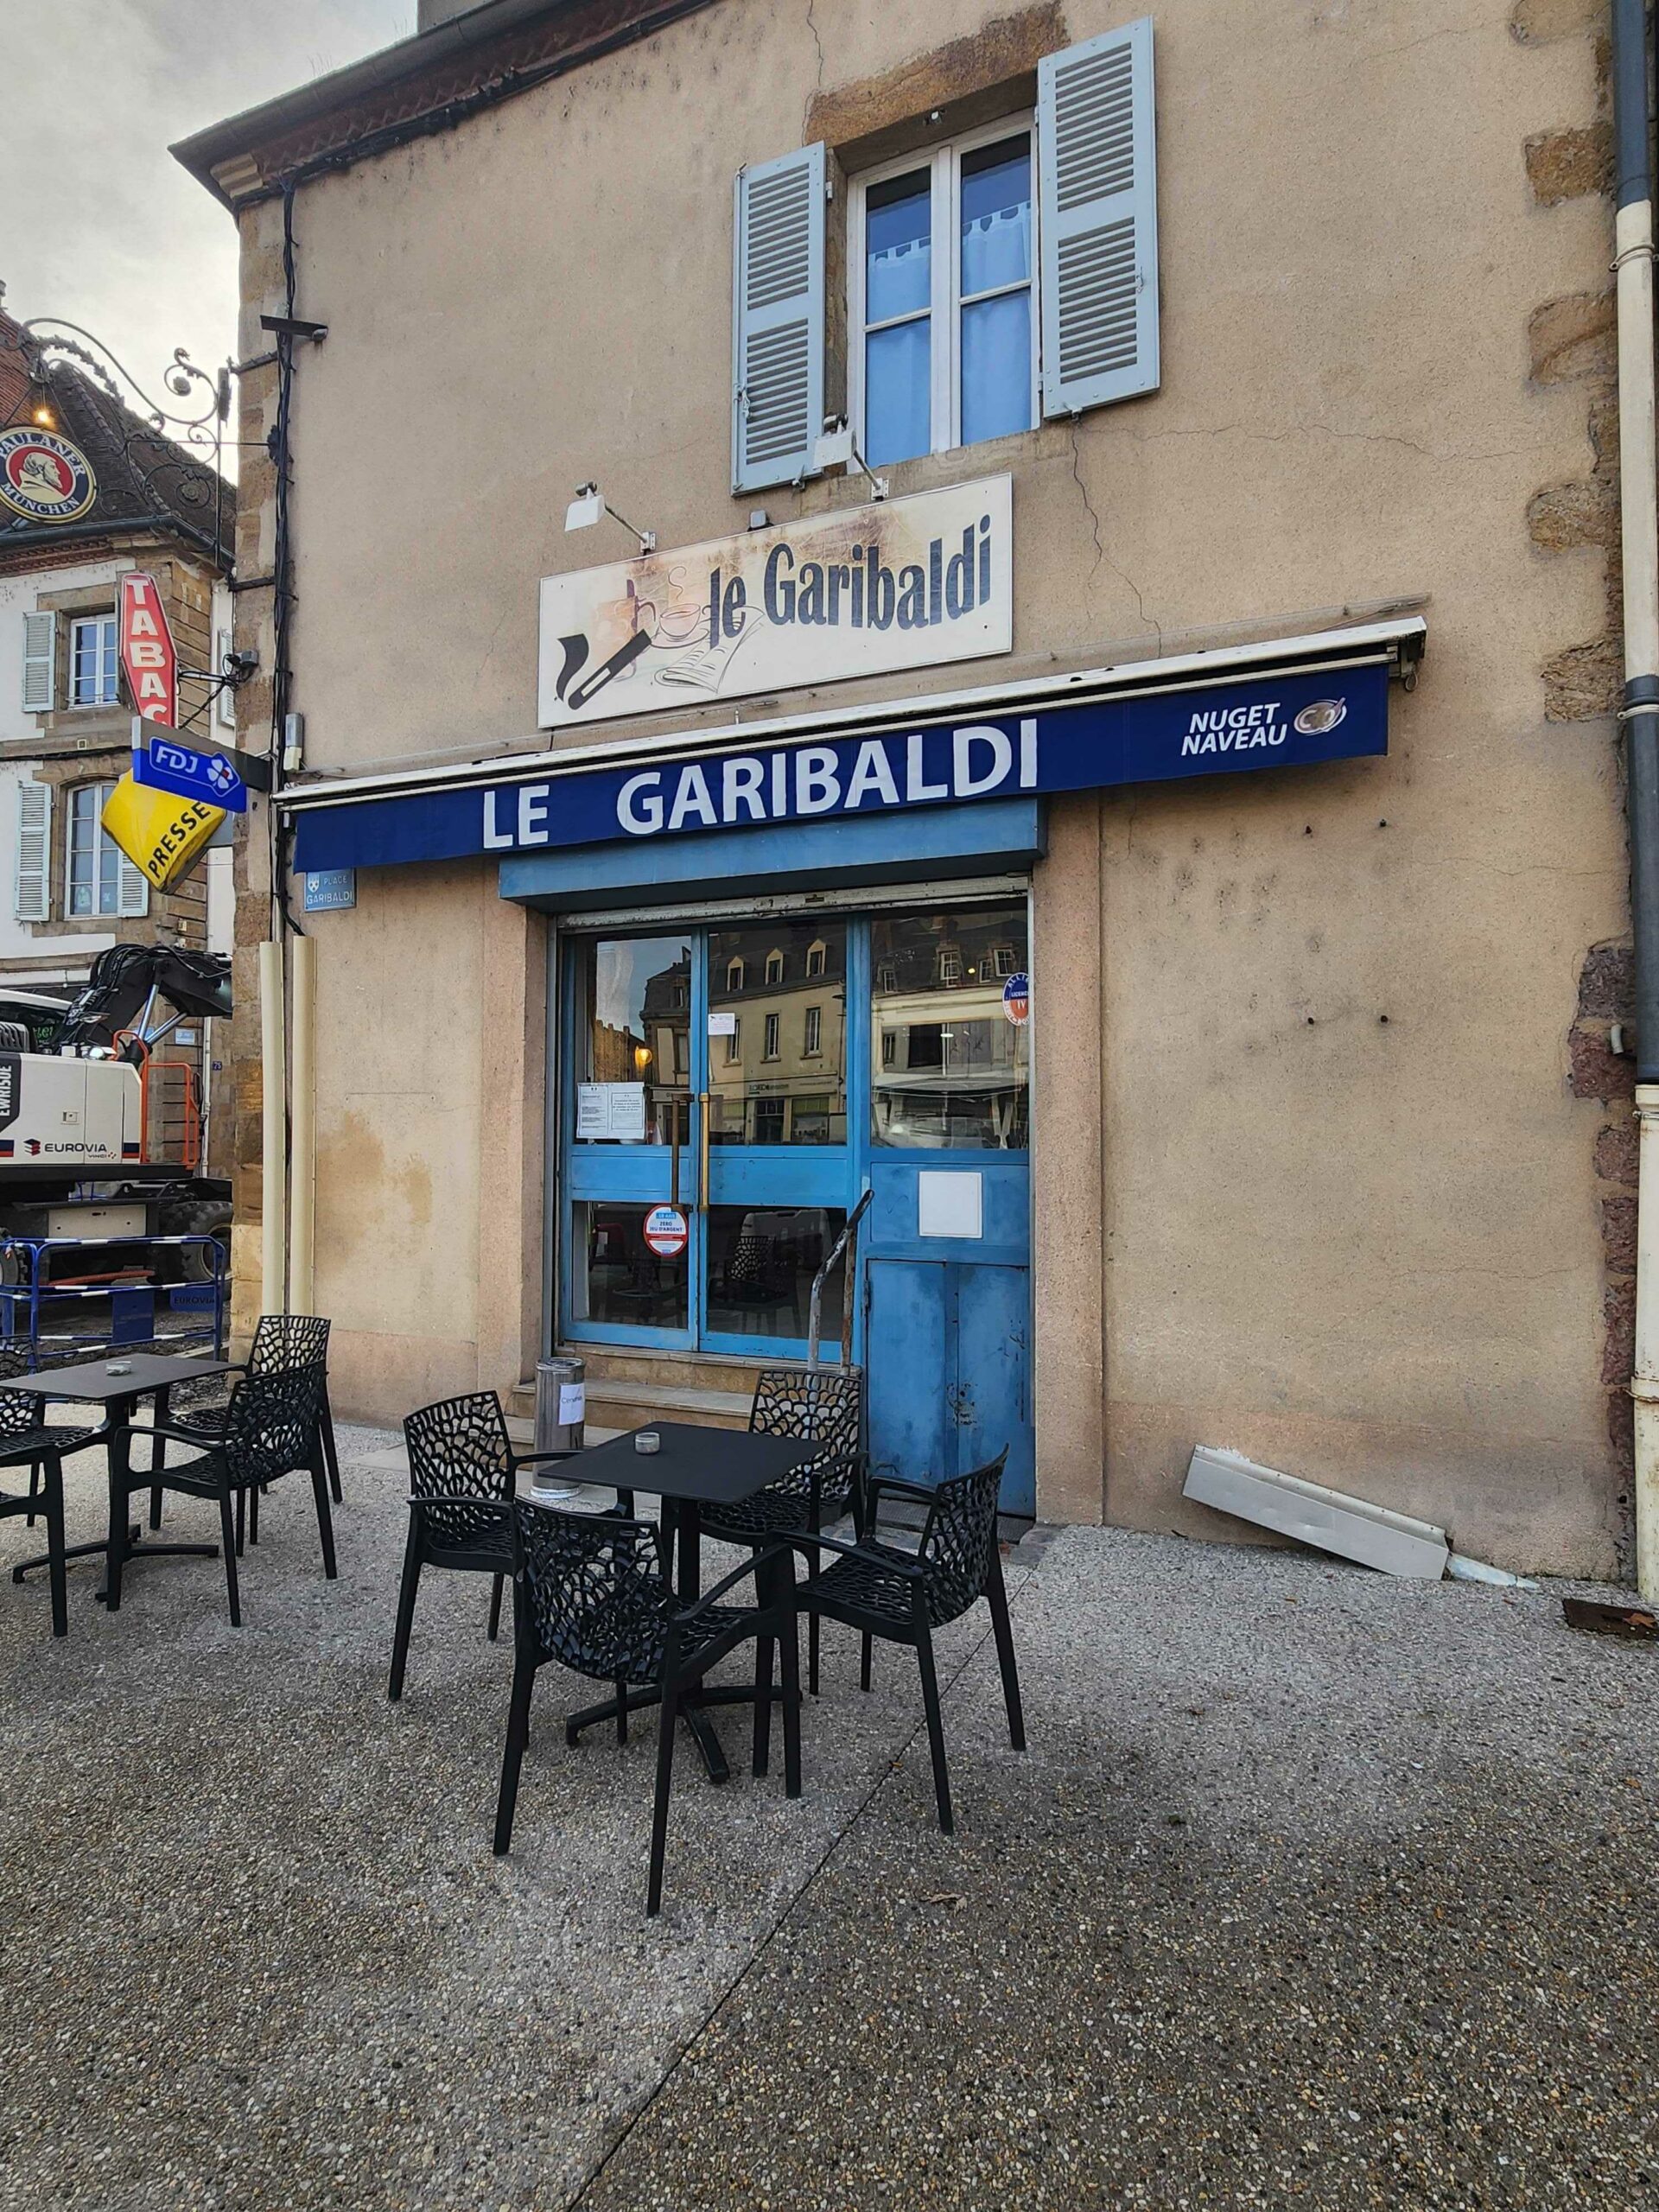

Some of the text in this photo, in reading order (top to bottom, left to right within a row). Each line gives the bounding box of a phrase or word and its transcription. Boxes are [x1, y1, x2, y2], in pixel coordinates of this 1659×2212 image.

[0, 433, 86, 476] PAULANER
[710, 514, 991, 649] le Garibaldi
[1189, 702, 1281, 734] NUGET
[1181, 724, 1287, 756] NAVEAU
[156, 745, 198, 773] FDJ
[483, 719, 1037, 849] LE GARIBALDI
[148, 802, 211, 880] PRESSE
[323, 876, 347, 886] PLACE
[306, 891, 353, 905] GARIBALDI
[44, 1142, 107, 1153] EUROVIA
